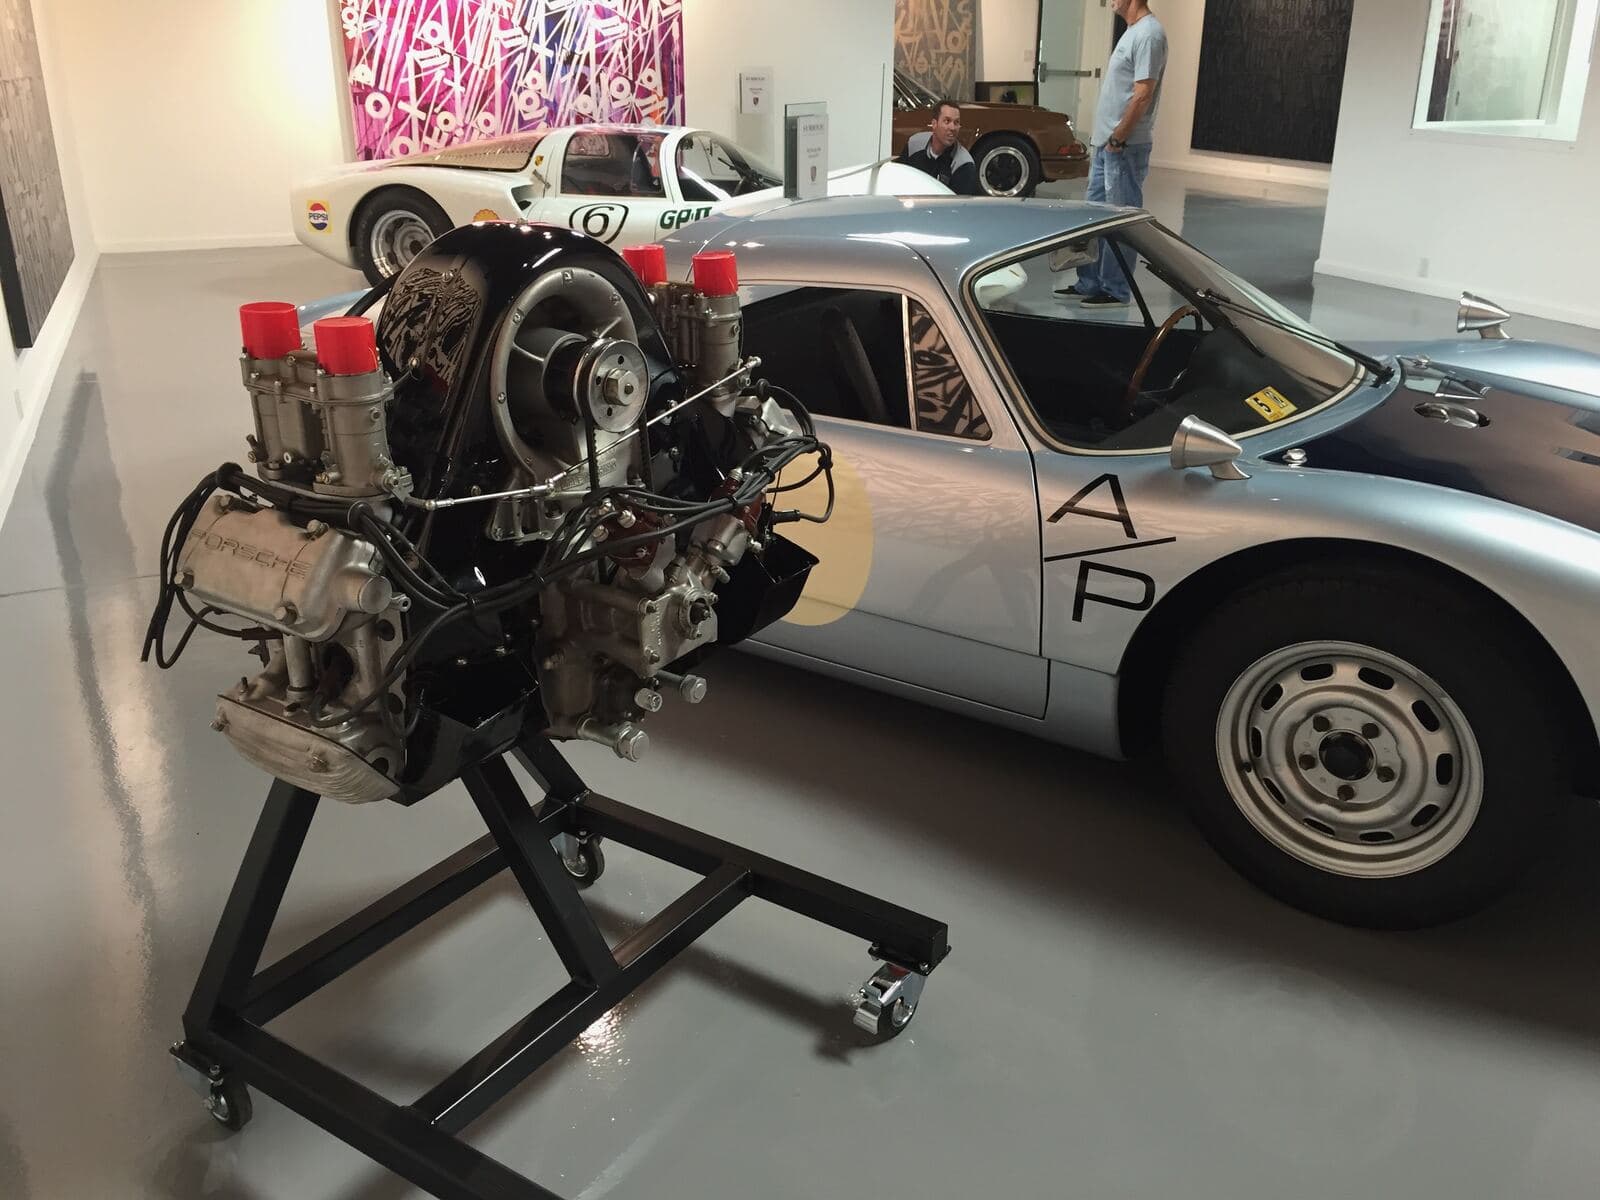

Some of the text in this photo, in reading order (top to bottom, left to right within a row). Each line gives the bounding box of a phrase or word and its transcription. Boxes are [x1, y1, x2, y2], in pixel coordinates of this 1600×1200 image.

[308, 212, 329, 221] PEPSI
[582, 205, 615, 238] 6
[1045, 472, 1138, 540] A
[188, 528, 313, 581] PORSCHE
[1071, 559, 1156, 623] P
